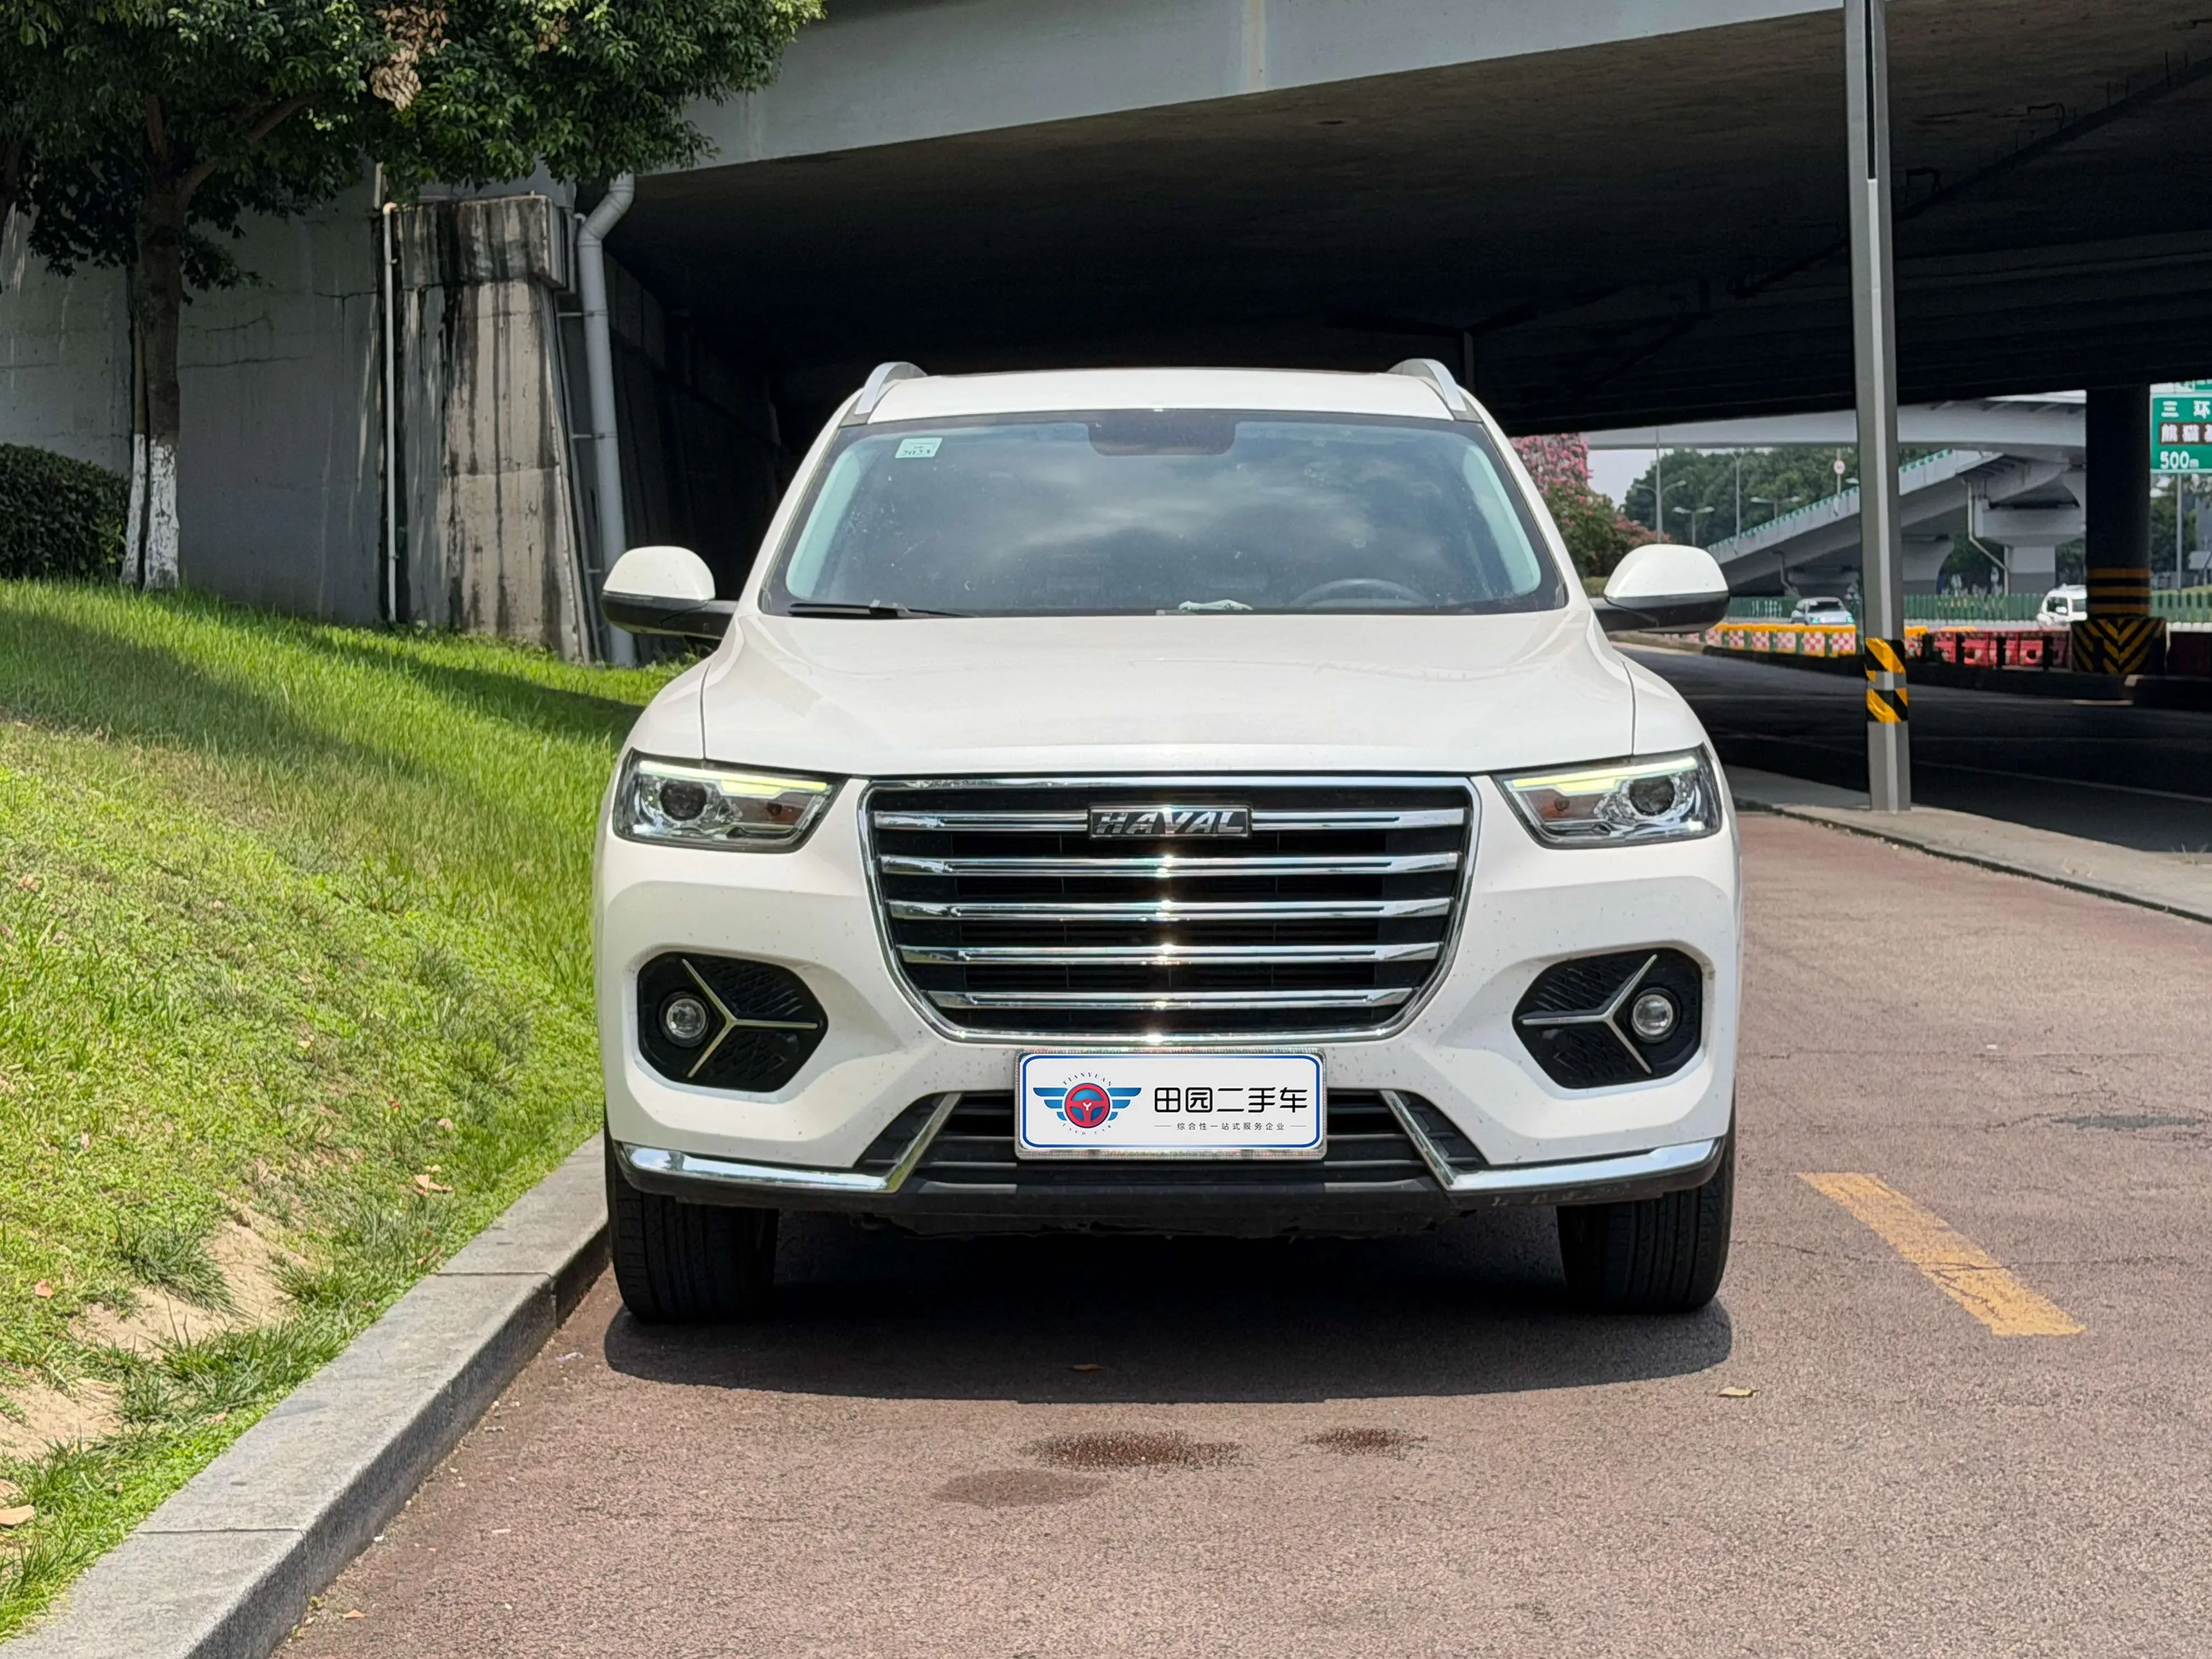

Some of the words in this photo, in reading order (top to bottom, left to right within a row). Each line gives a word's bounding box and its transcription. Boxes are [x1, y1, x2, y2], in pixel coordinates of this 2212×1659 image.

[2160, 450, 2199, 469] 500m
[1096, 811, 1244, 834] HAVAL
[1154, 1087, 1308, 1113] 田园二手车
[1177, 1122, 1285, 1131] 综合性一站式服务企业
